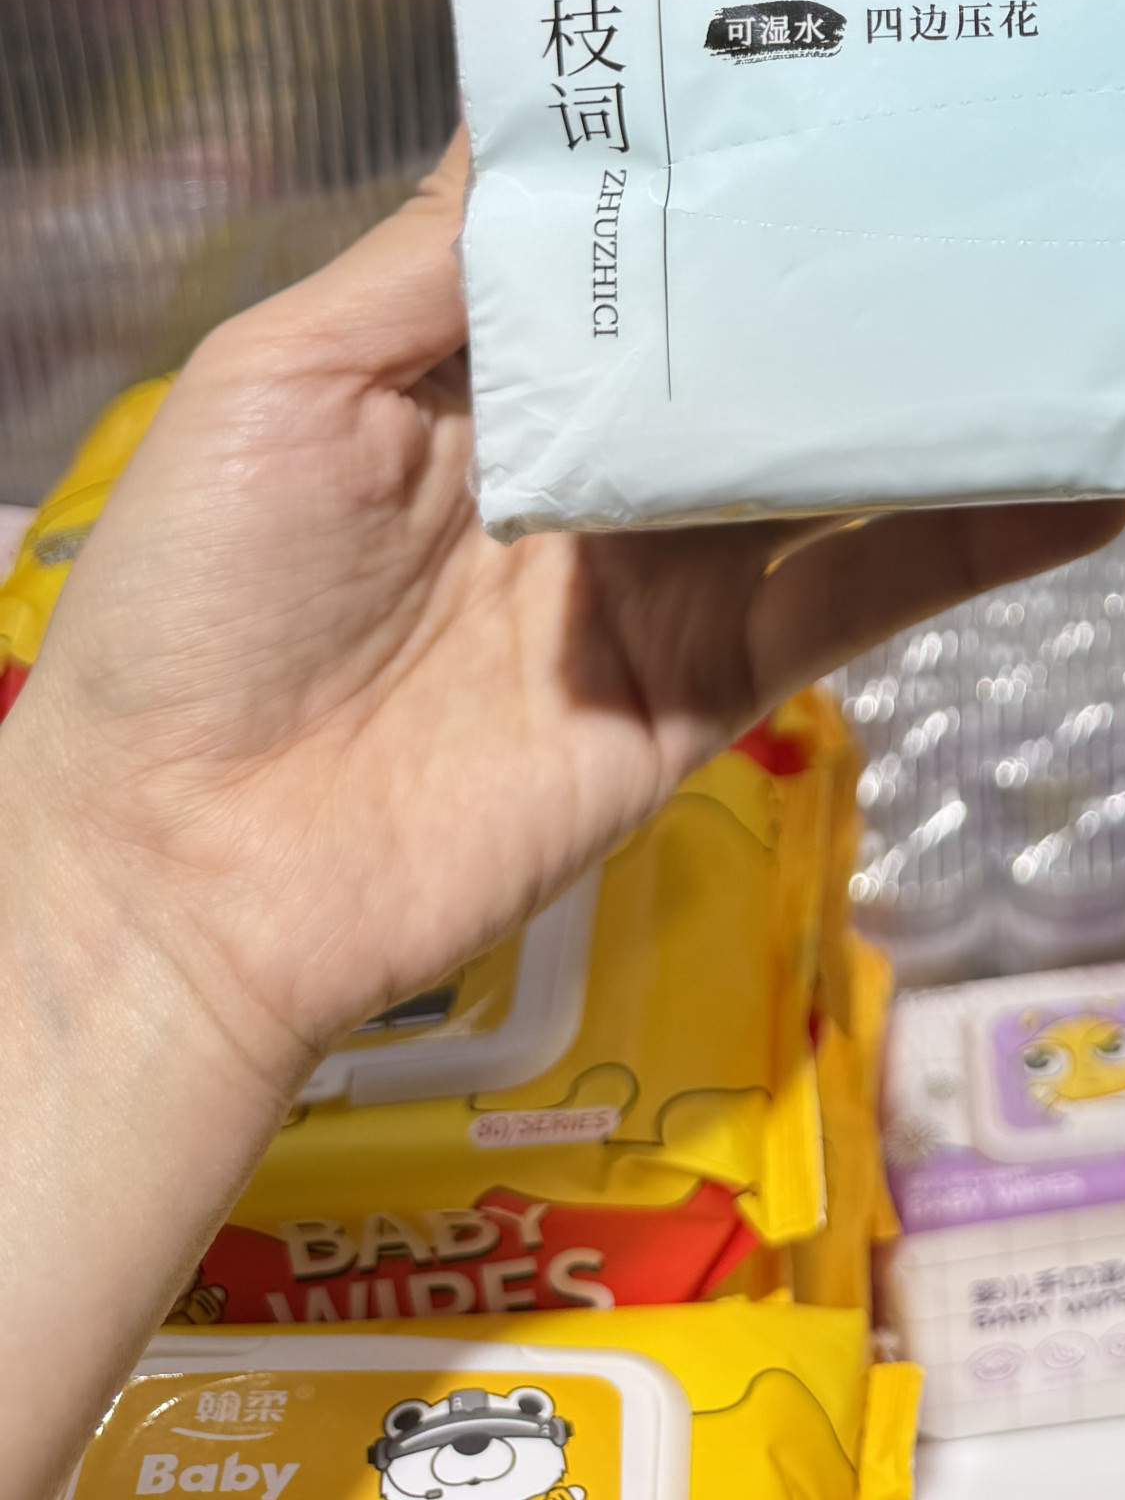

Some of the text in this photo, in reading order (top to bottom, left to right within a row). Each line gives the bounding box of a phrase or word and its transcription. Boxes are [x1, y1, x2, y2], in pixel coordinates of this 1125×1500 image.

[724, 13, 827, 46] 可湿水
[866, 0, 1040, 45] 四边压花
[591, 168, 628, 339] ZHUZHICI
[283, 1202, 550, 1283] BABY
[135, 1451, 301, 1500] Baby
